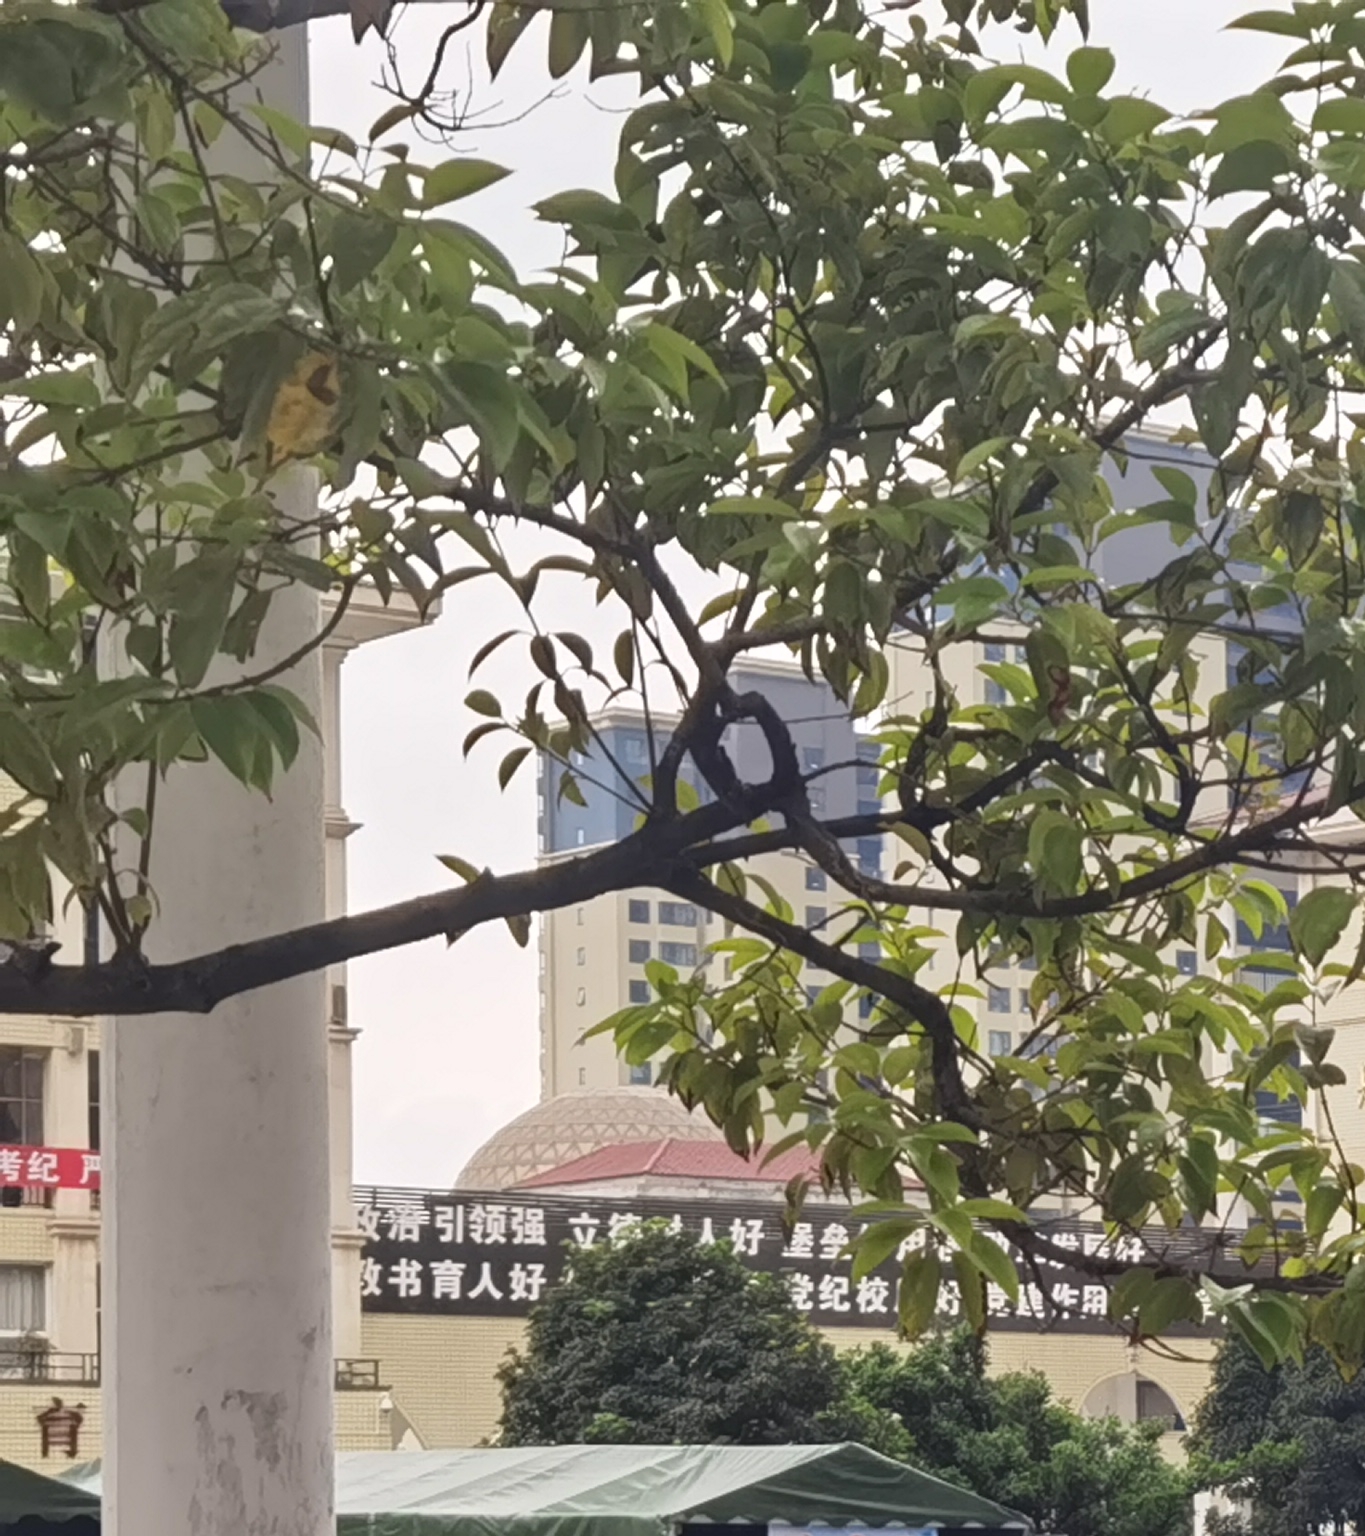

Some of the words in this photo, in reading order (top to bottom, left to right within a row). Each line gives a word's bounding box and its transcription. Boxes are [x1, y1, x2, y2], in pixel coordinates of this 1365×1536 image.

[568, 1212, 765, 1256] 立德人好
[789, 1272, 962, 1317] 党纪校好
